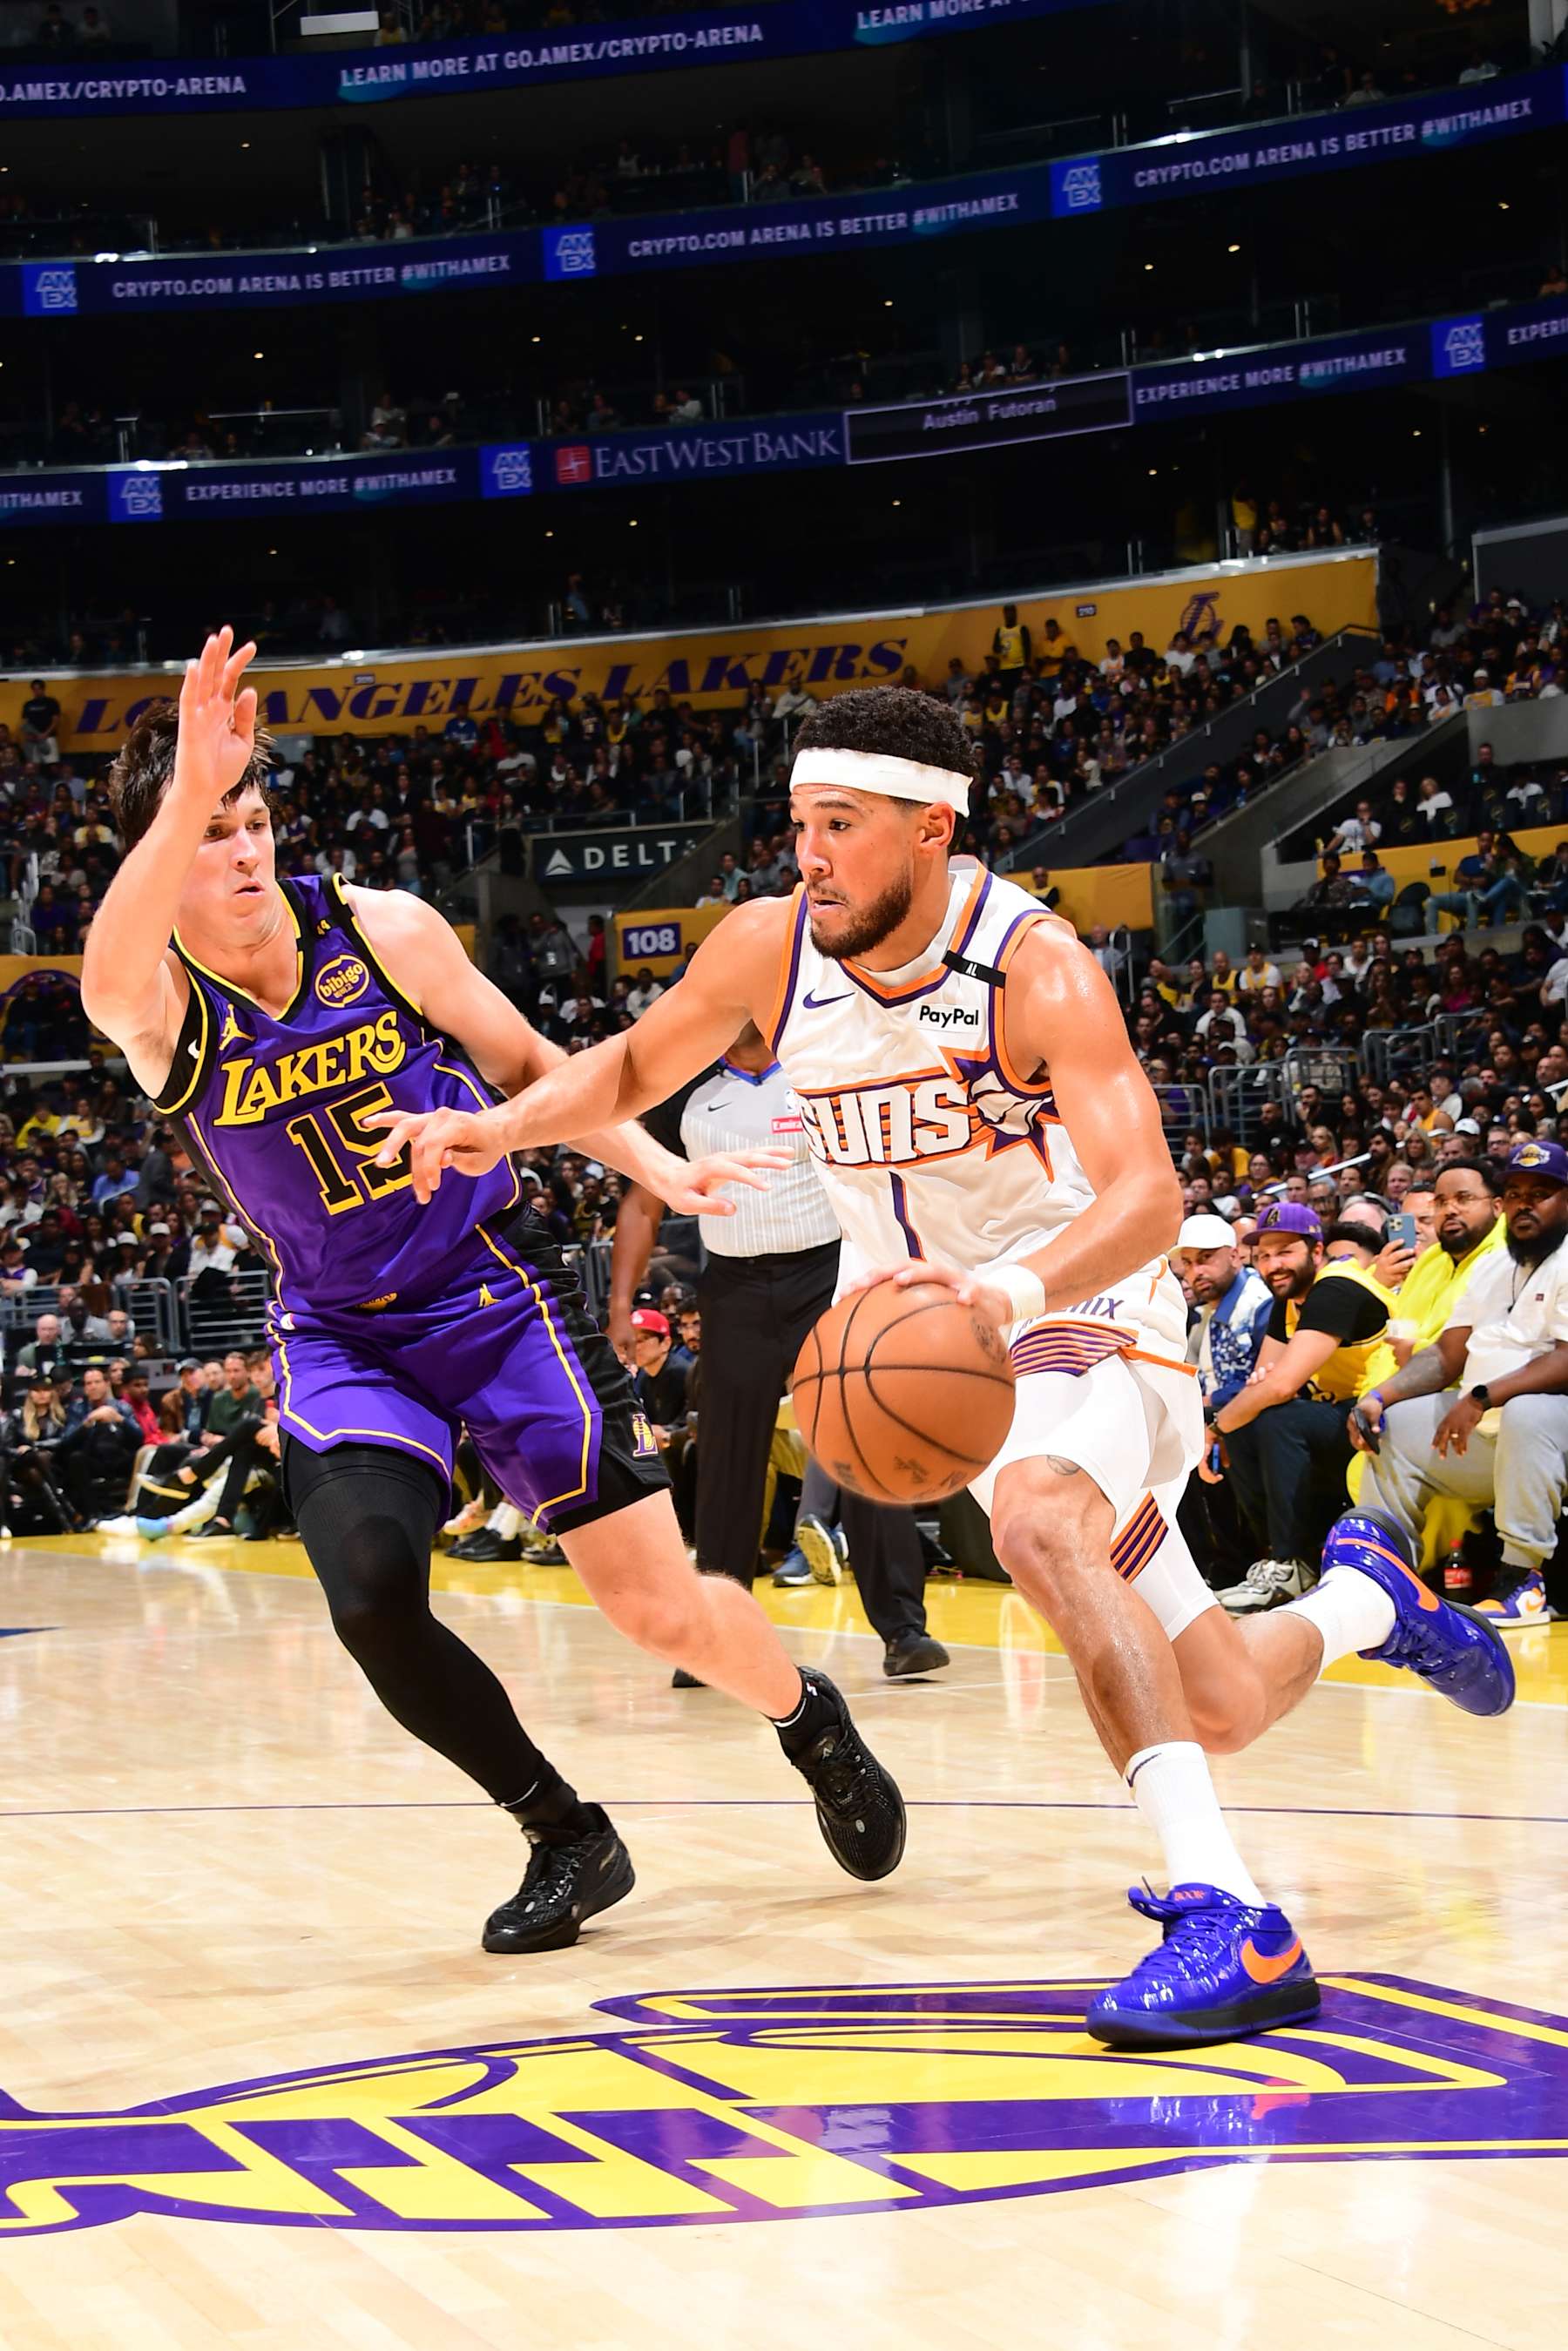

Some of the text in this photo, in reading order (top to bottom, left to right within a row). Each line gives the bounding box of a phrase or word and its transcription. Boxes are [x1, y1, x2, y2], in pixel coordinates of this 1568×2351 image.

[857, 3, 924, 30] LEARN
[341, 24, 764, 87] LEARN MORE AT GO.AMEX/CRYPTO-ARENA
[1134, 98, 1533, 189] CRYPTO.COM ARENA IS BETTER #WITHAMEX
[629, 193, 1019, 258] CRYPTO.COM ARENA IS BETTER #WITHAMEX
[112, 254, 511, 299] CRYPTO.COM ARENA IS BETTER #WITHAMEX
[1136, 348, 1407, 405] EXPERIENCE MORE #WITHAMEX
[923, 398, 1056, 431] Austin Futoran
[186, 469, 457, 502] EXPERIENCE MORE #WITHAMEX
[260, 668, 584, 725] ANGELES
[601, 638, 908, 699] LAKERS
[628, 928, 677, 955] 108
[320, 963, 363, 997] bibigo
[965, 963, 977, 976] AL
[919, 1005, 979, 1028] PayPal
[213, 1010, 406, 1125] LAKERS
[286, 1081, 414, 1215] 15
